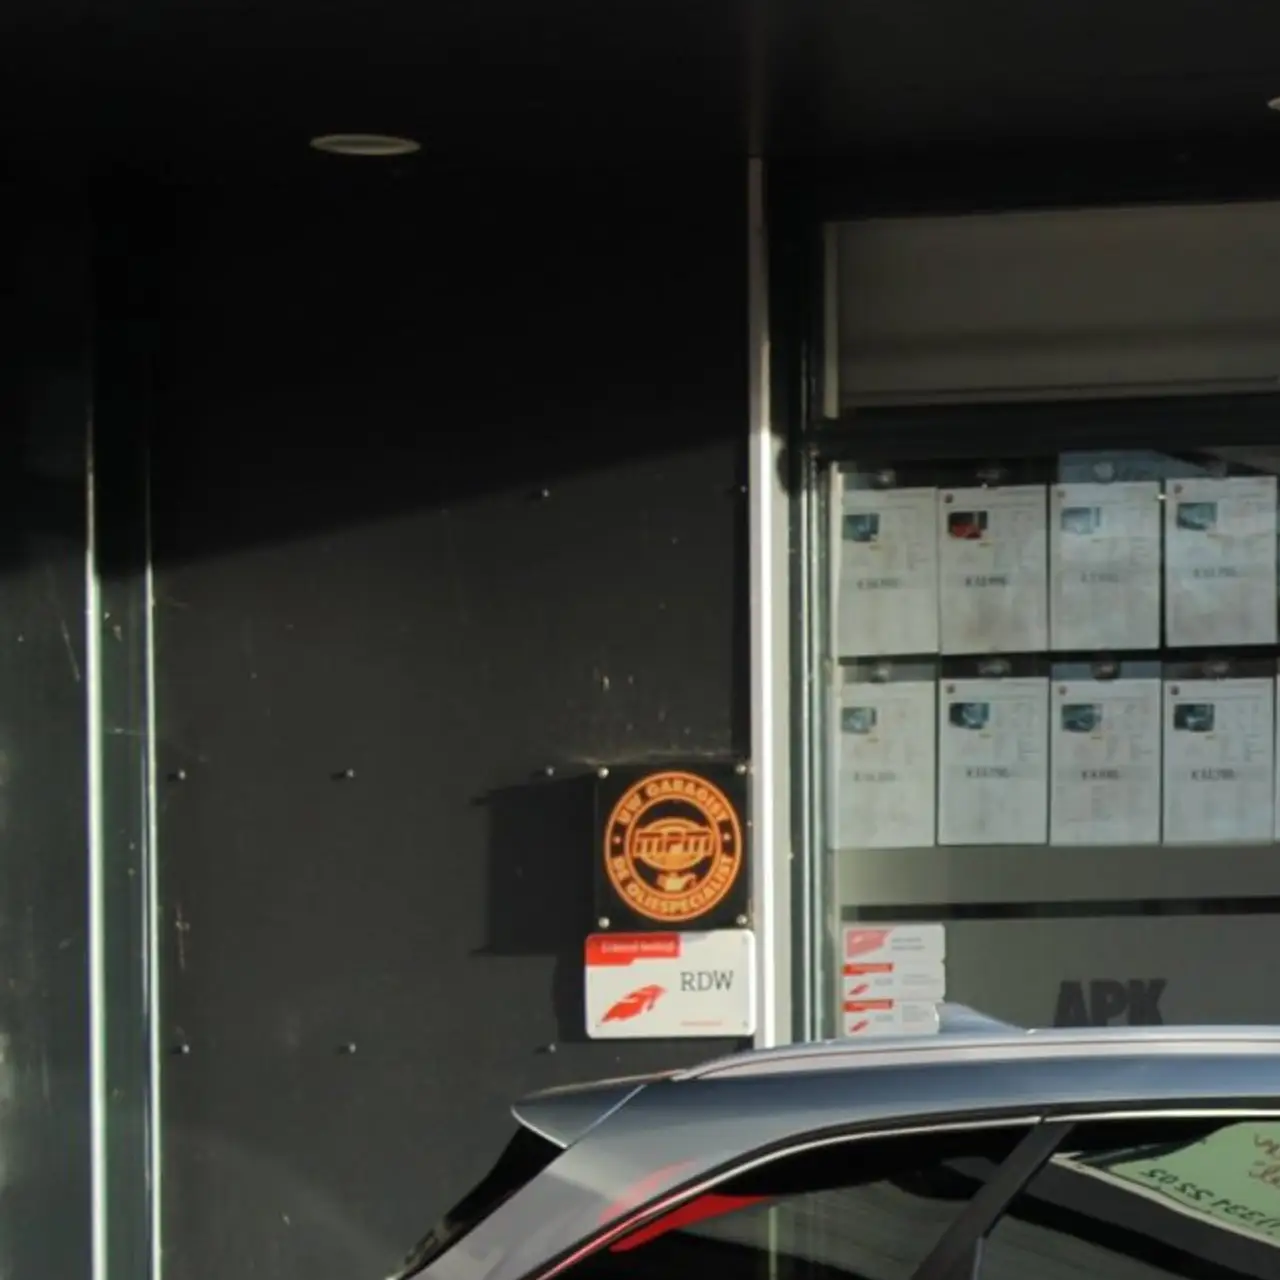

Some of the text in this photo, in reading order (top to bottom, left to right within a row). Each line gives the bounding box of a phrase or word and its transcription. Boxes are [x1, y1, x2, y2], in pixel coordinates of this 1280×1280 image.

[646, 779, 729, 822] GARAGIST
[626, 854, 734, 913] OLIESPECIALIST
[680, 970, 734, 992] RDW
[1053, 979, 1168, 1027] APK
